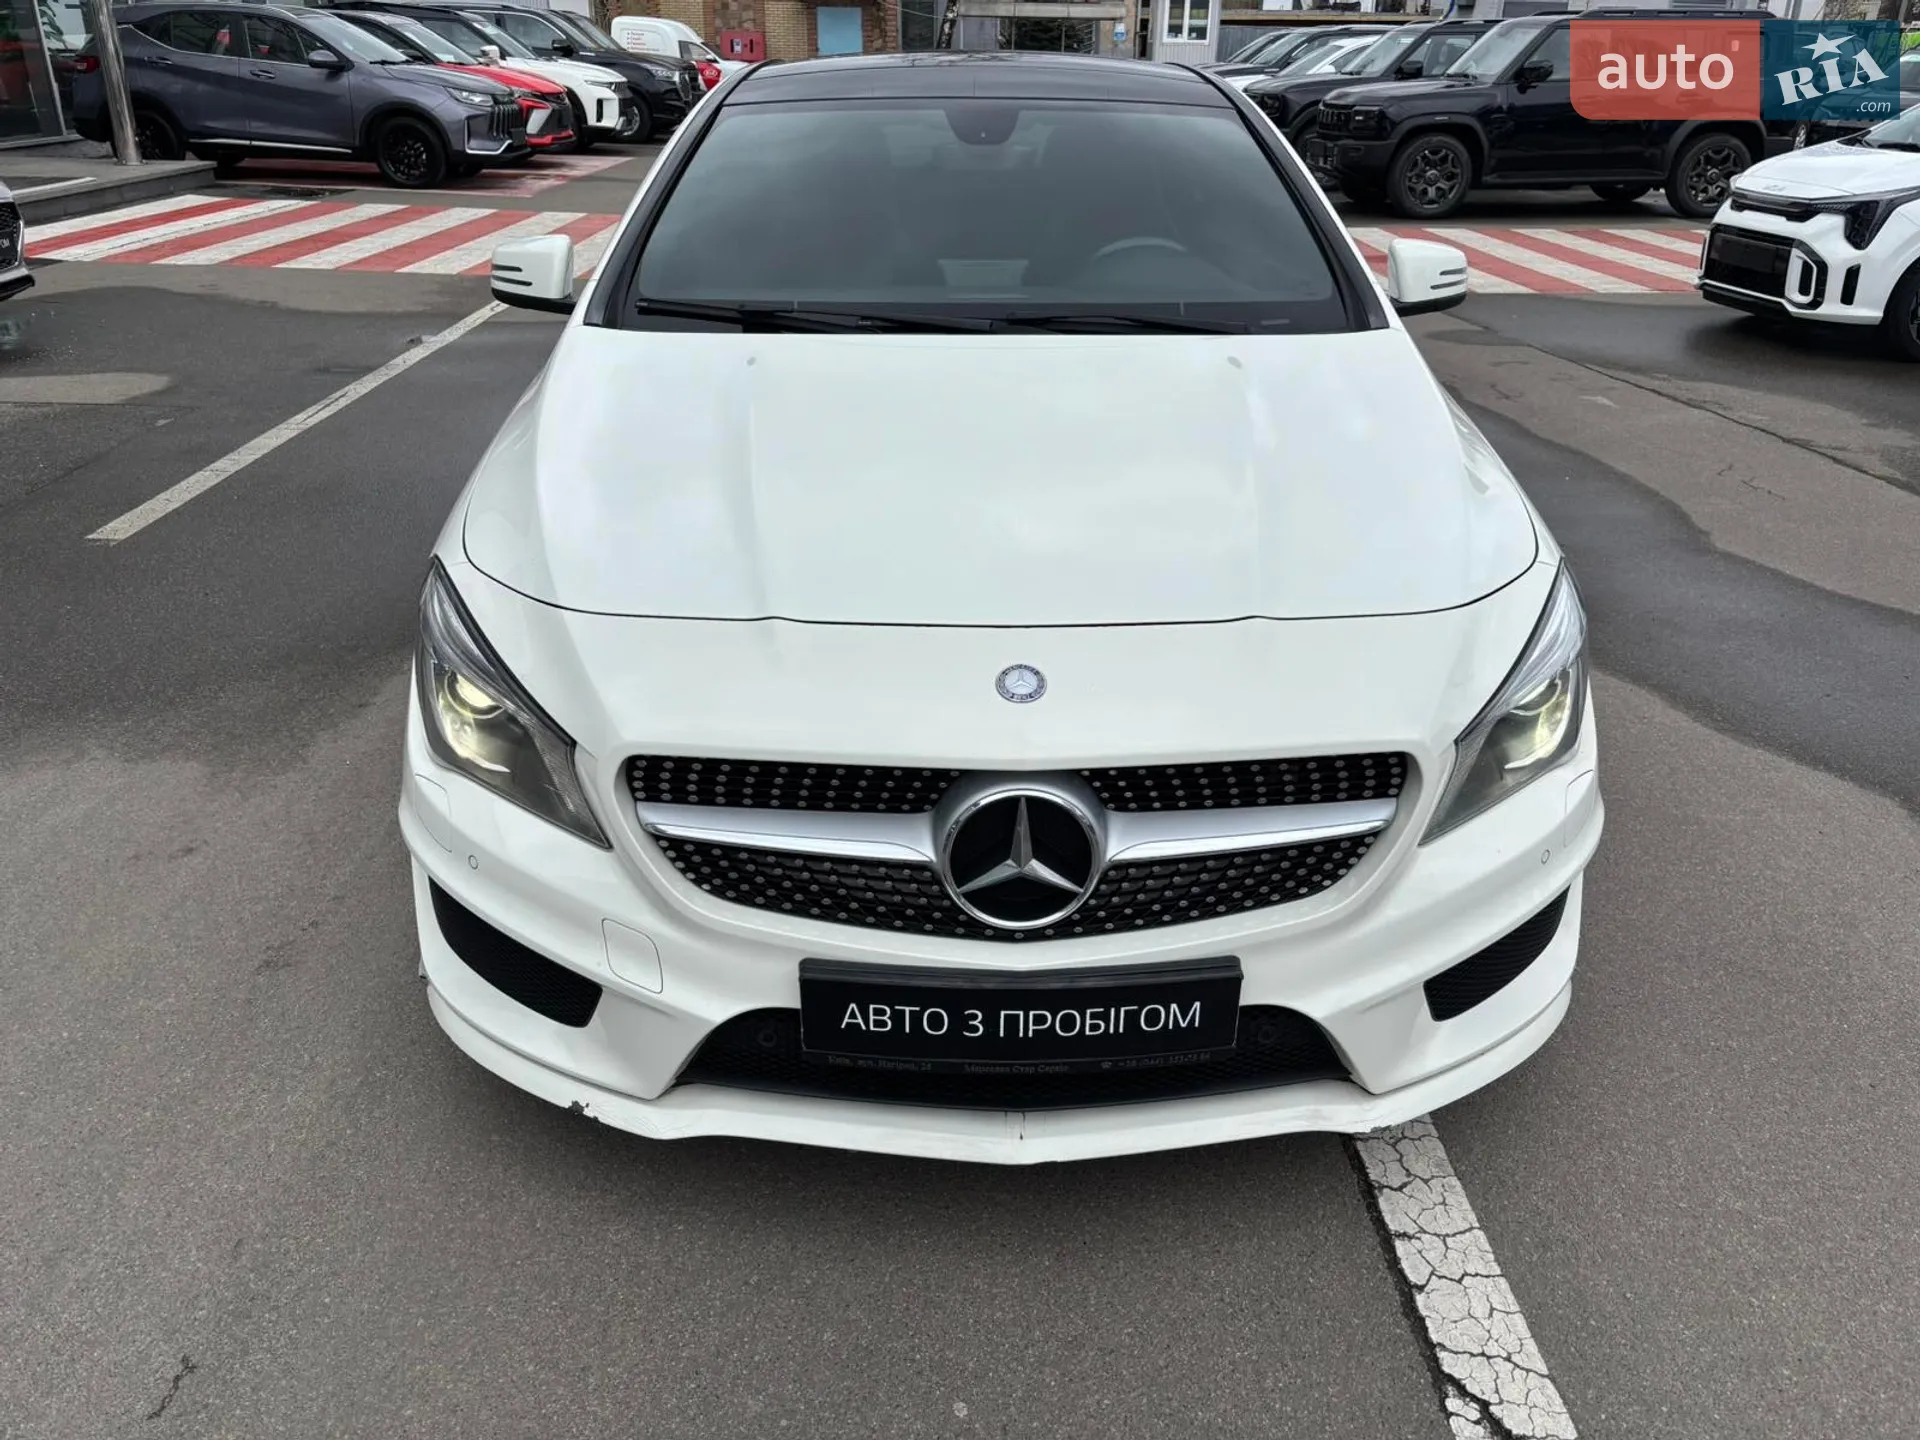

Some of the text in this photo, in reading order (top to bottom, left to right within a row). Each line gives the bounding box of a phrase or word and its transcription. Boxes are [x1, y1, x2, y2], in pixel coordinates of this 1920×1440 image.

[840, 1001, 1202, 1038] АВТО З ПРОБІГОМ
